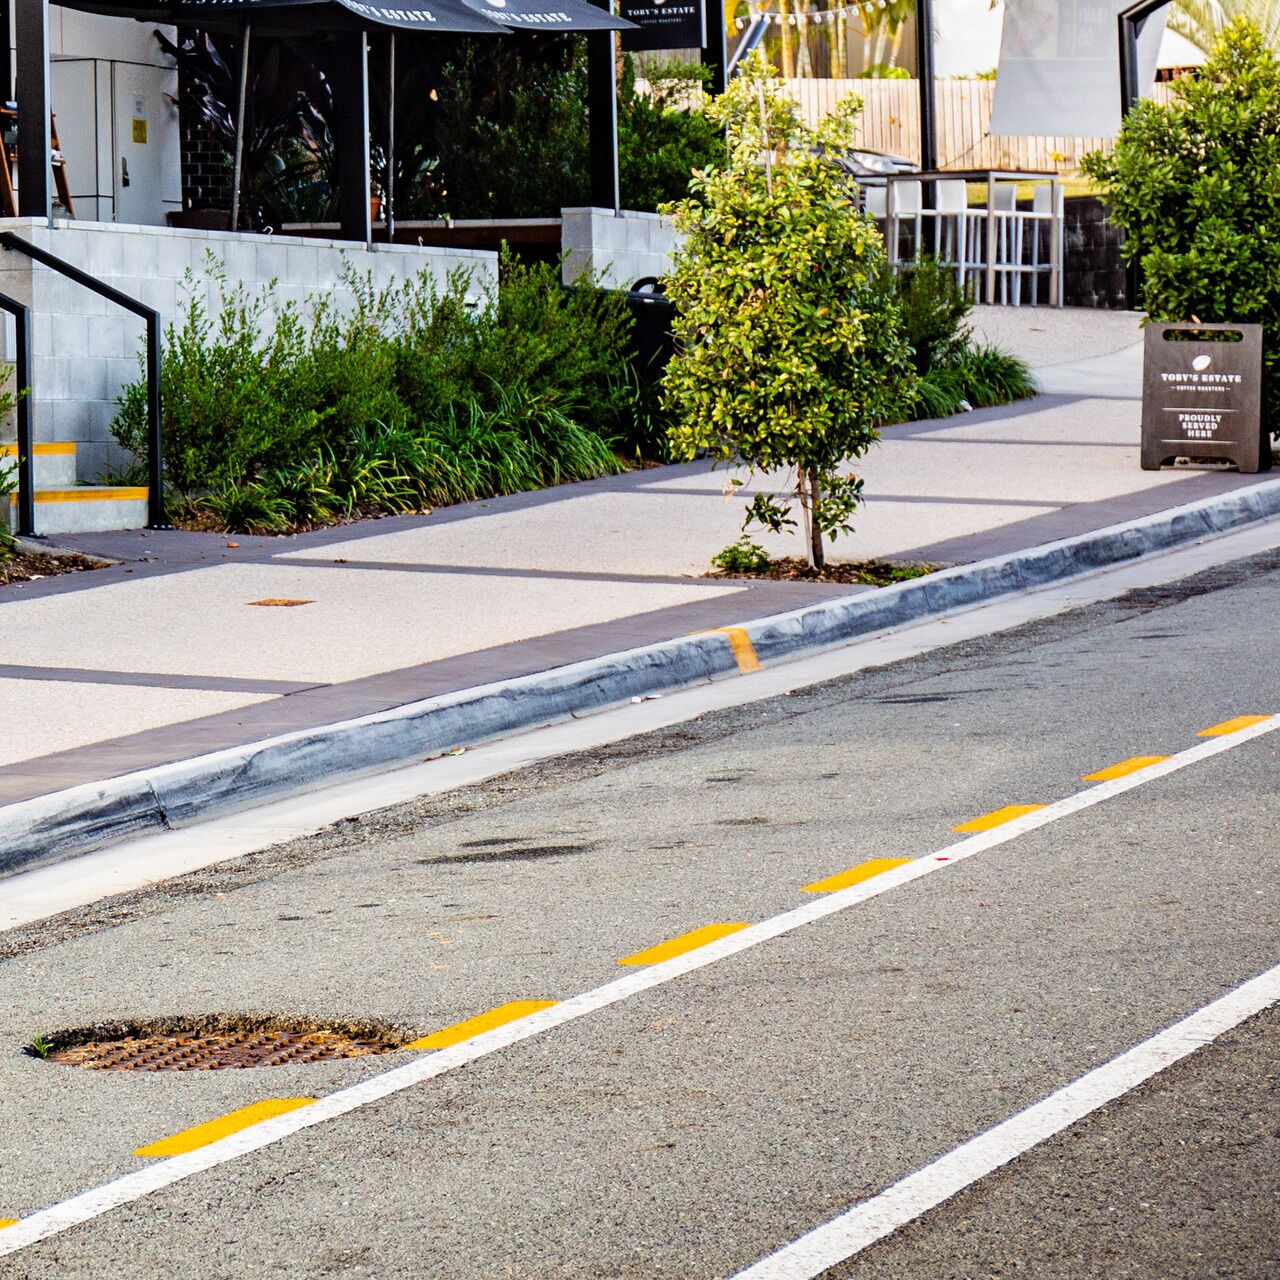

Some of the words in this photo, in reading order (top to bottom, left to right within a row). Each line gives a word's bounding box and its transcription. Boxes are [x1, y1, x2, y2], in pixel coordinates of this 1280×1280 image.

[380, 8, 437, 22] ESTATE
[627, 8, 659, 16] TOBY'S
[661, 6, 696, 15] ESTATE
[519, 12, 572, 23] ESTATE
[1161, 373, 1199, 382] TOBY'S
[1201, 374, 1242, 383] ESTATE
[1178, 414, 1222, 423] PROUDLY
[1182, 422, 1218, 431] SERVED
[1187, 429, 1213, 438] HERE
